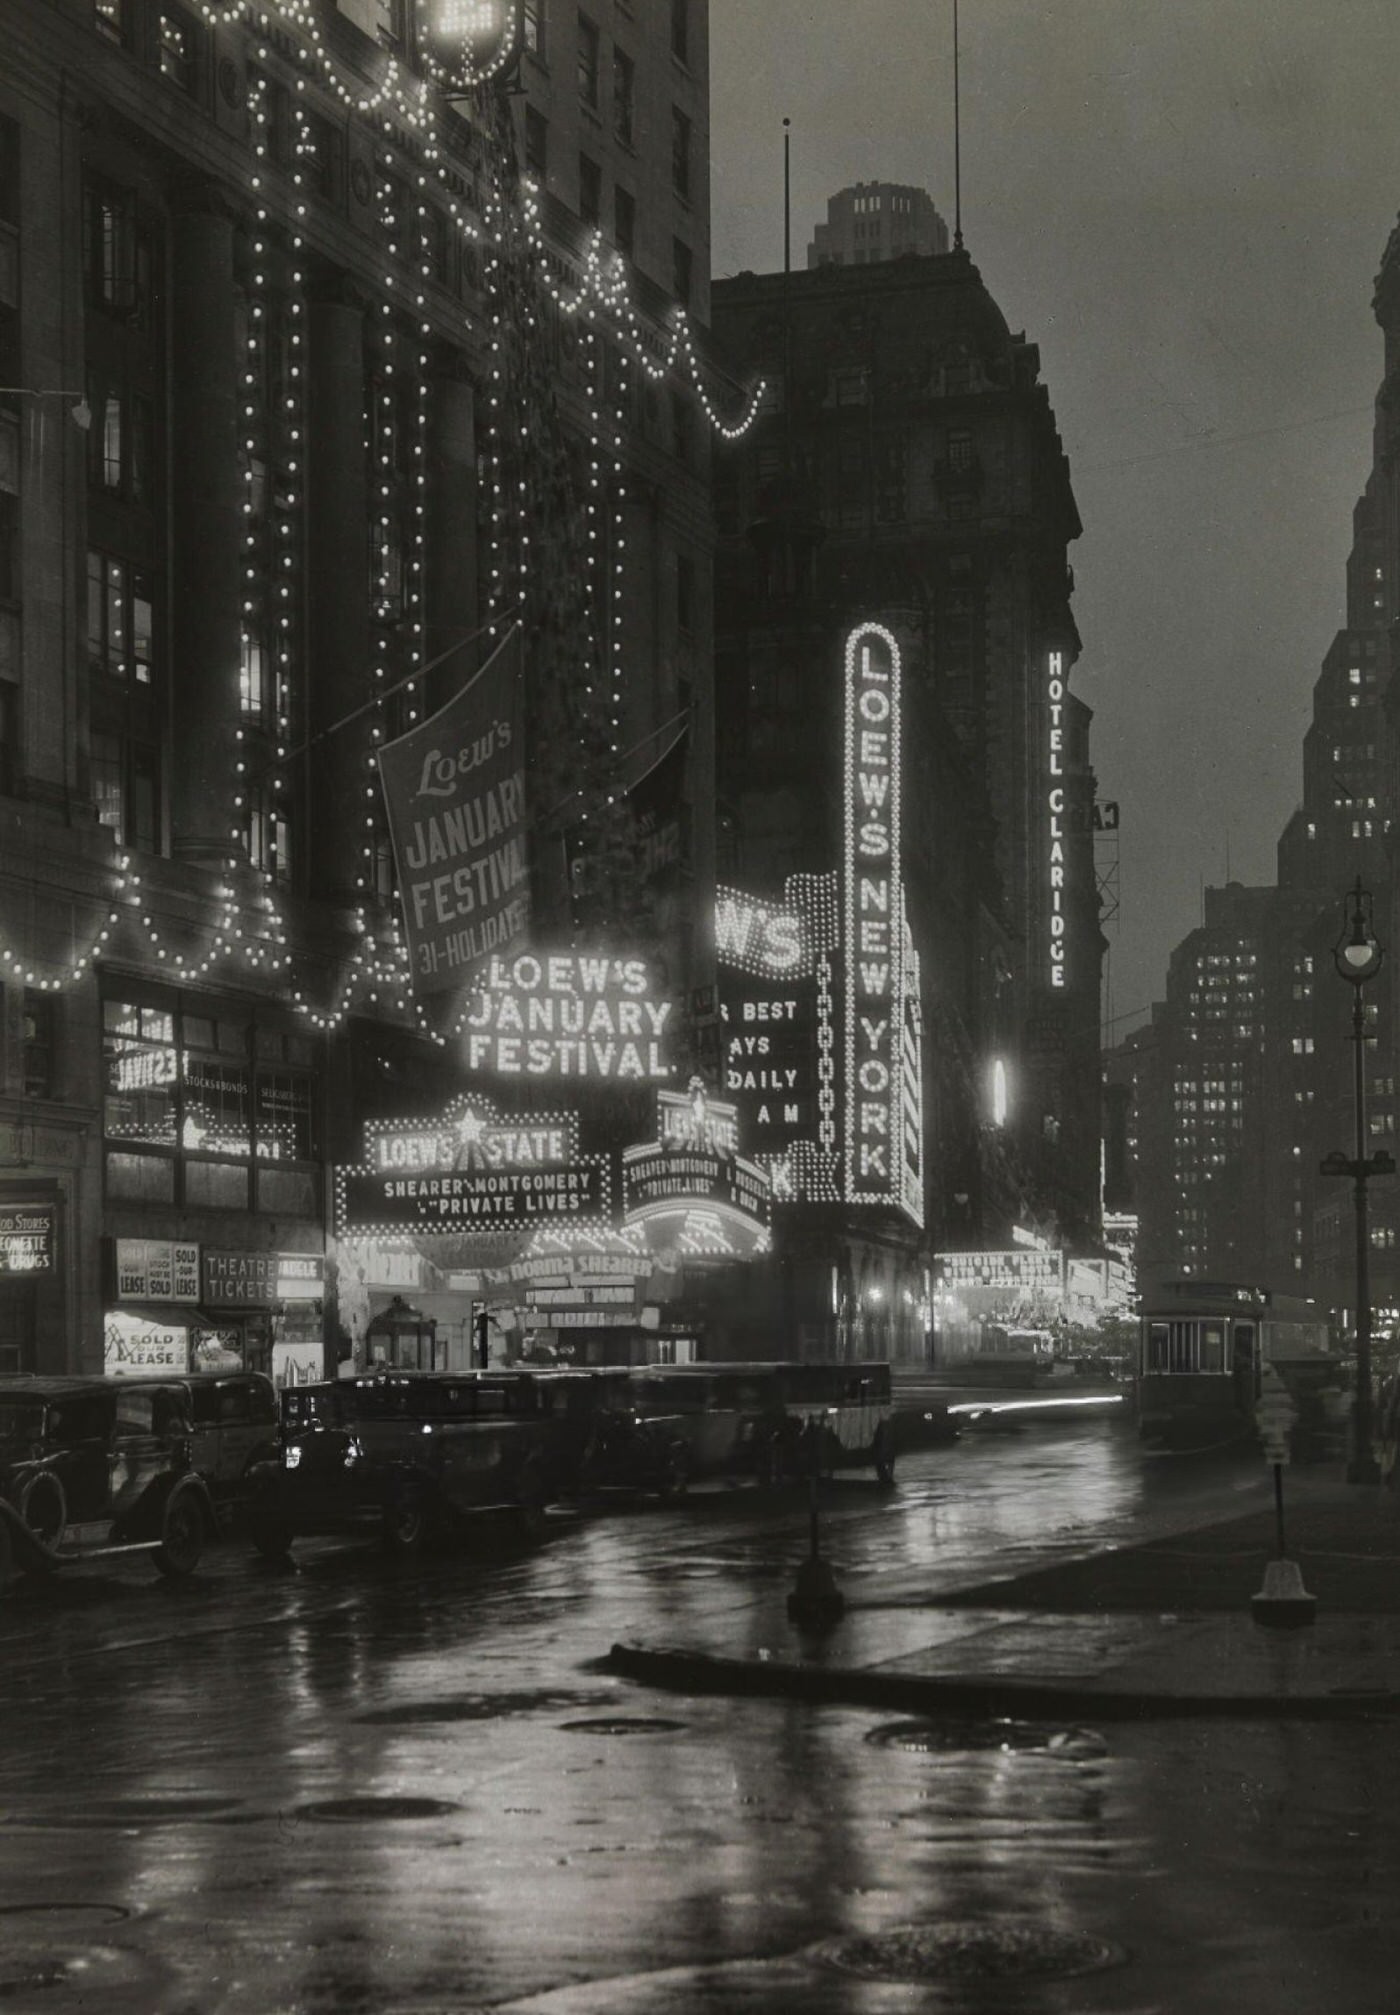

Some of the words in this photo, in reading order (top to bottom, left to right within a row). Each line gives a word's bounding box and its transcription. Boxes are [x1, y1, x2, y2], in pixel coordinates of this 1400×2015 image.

[1048, 652, 1063, 776] HOTEL
[1048, 789, 1065, 987] CLARIDGE
[860, 878, 888, 995] NEW
[489, 954, 648, 994] LOEW'S
[468, 994, 672, 1036] JANUARY
[743, 1001, 797, 1020] BEST
[469, 1035, 670, 1076] FESTIVAL
[727, 1069, 797, 1088] DAILY
[859, 1017, 889, 1177] YORK
[757, 1104, 770, 1123] A
[784, 1104, 799, 1123] M
[379, 1134, 454, 1169] LOEW'S
[487, 1129, 563, 1163] STATE
[384, 1178, 463, 1197] SHEARER
[475, 1173, 591, 1193] MONTGOMERY
[175, 1249, 196, 1263] SOLD
[207, 1257, 275, 1277] THEATRE
[120, 1276, 145, 1294] LEASE
[150, 1280, 171, 1295] SOLD
[176, 1279, 197, 1296] LEASE
[208, 1279, 274, 1298] TICKETS
[130, 1334, 174, 1345] SOLD
[130, 1353, 174, 1365] LEASE
